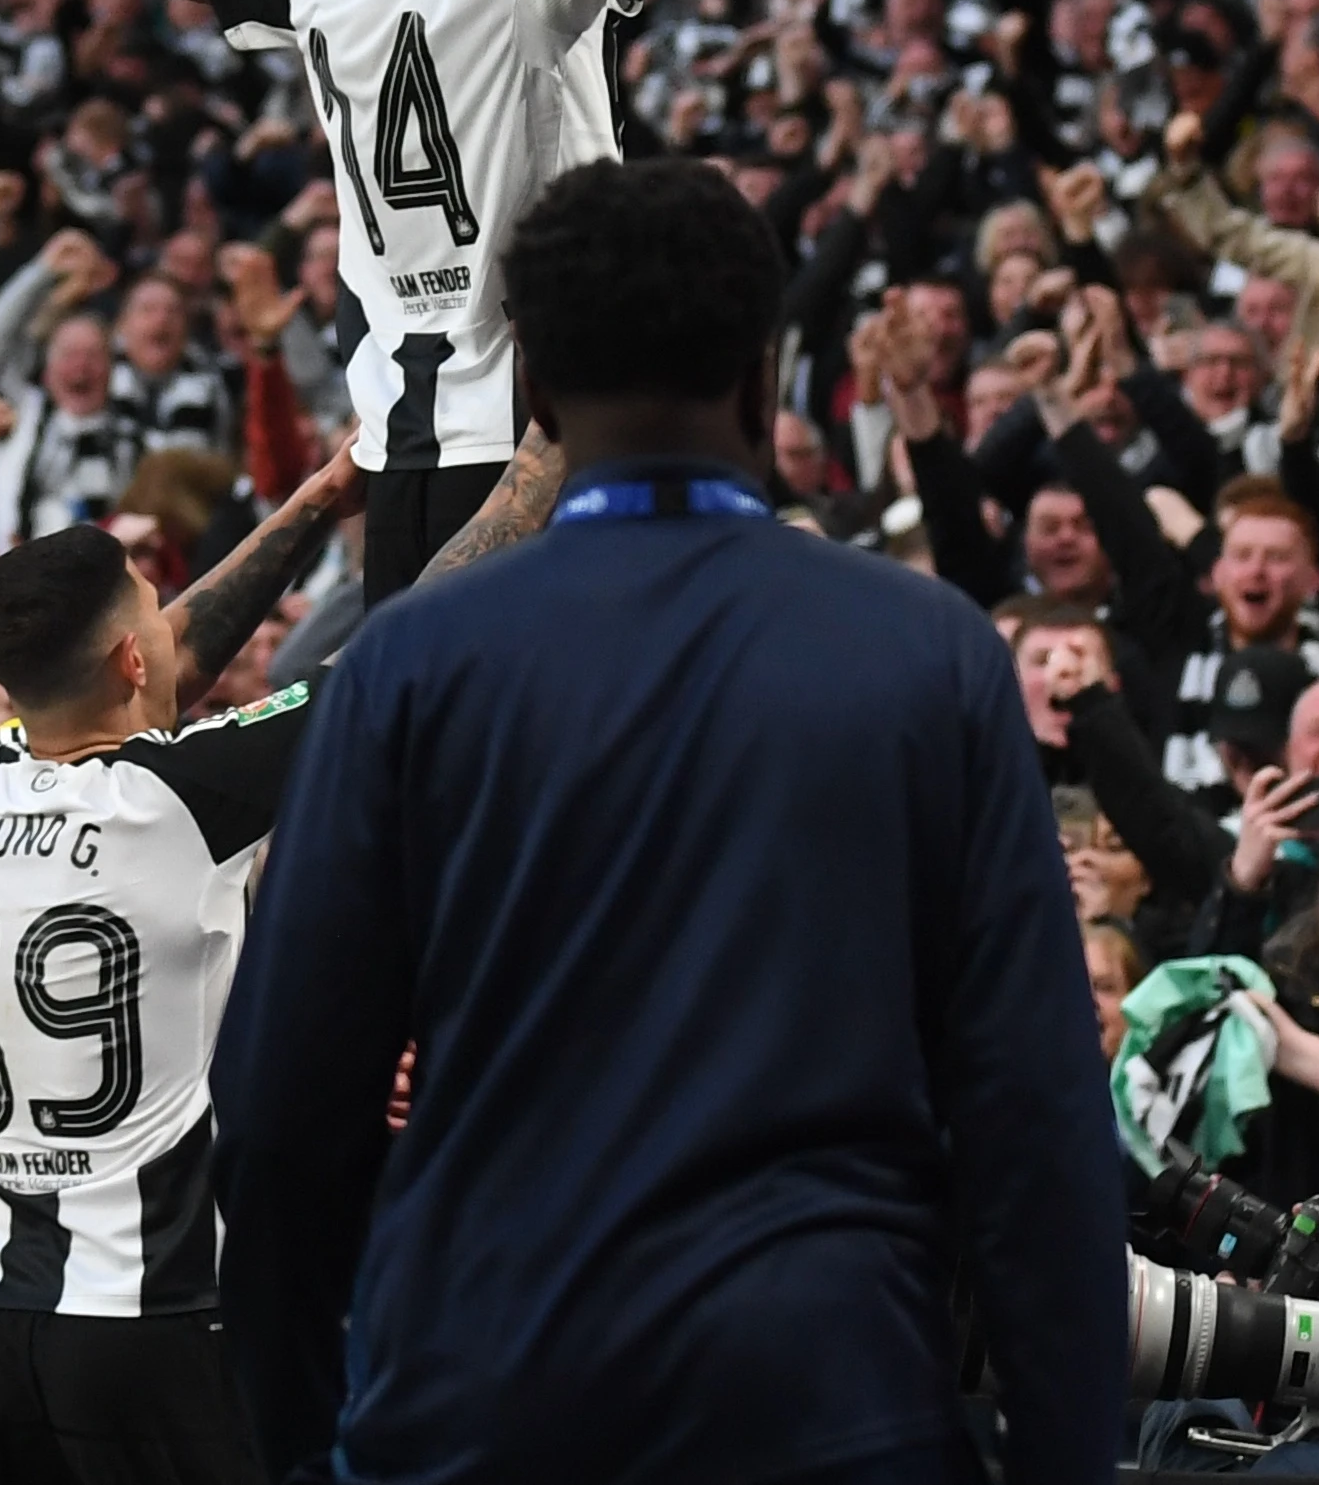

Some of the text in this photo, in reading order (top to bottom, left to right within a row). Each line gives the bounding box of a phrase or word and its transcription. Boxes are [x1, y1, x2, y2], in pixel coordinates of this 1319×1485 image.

[309, 10, 480, 256] 14
[418, 265, 471, 296] FENDER
[70, 822, 102, 877] G.
[22, 1149, 93, 1175] FENDER
